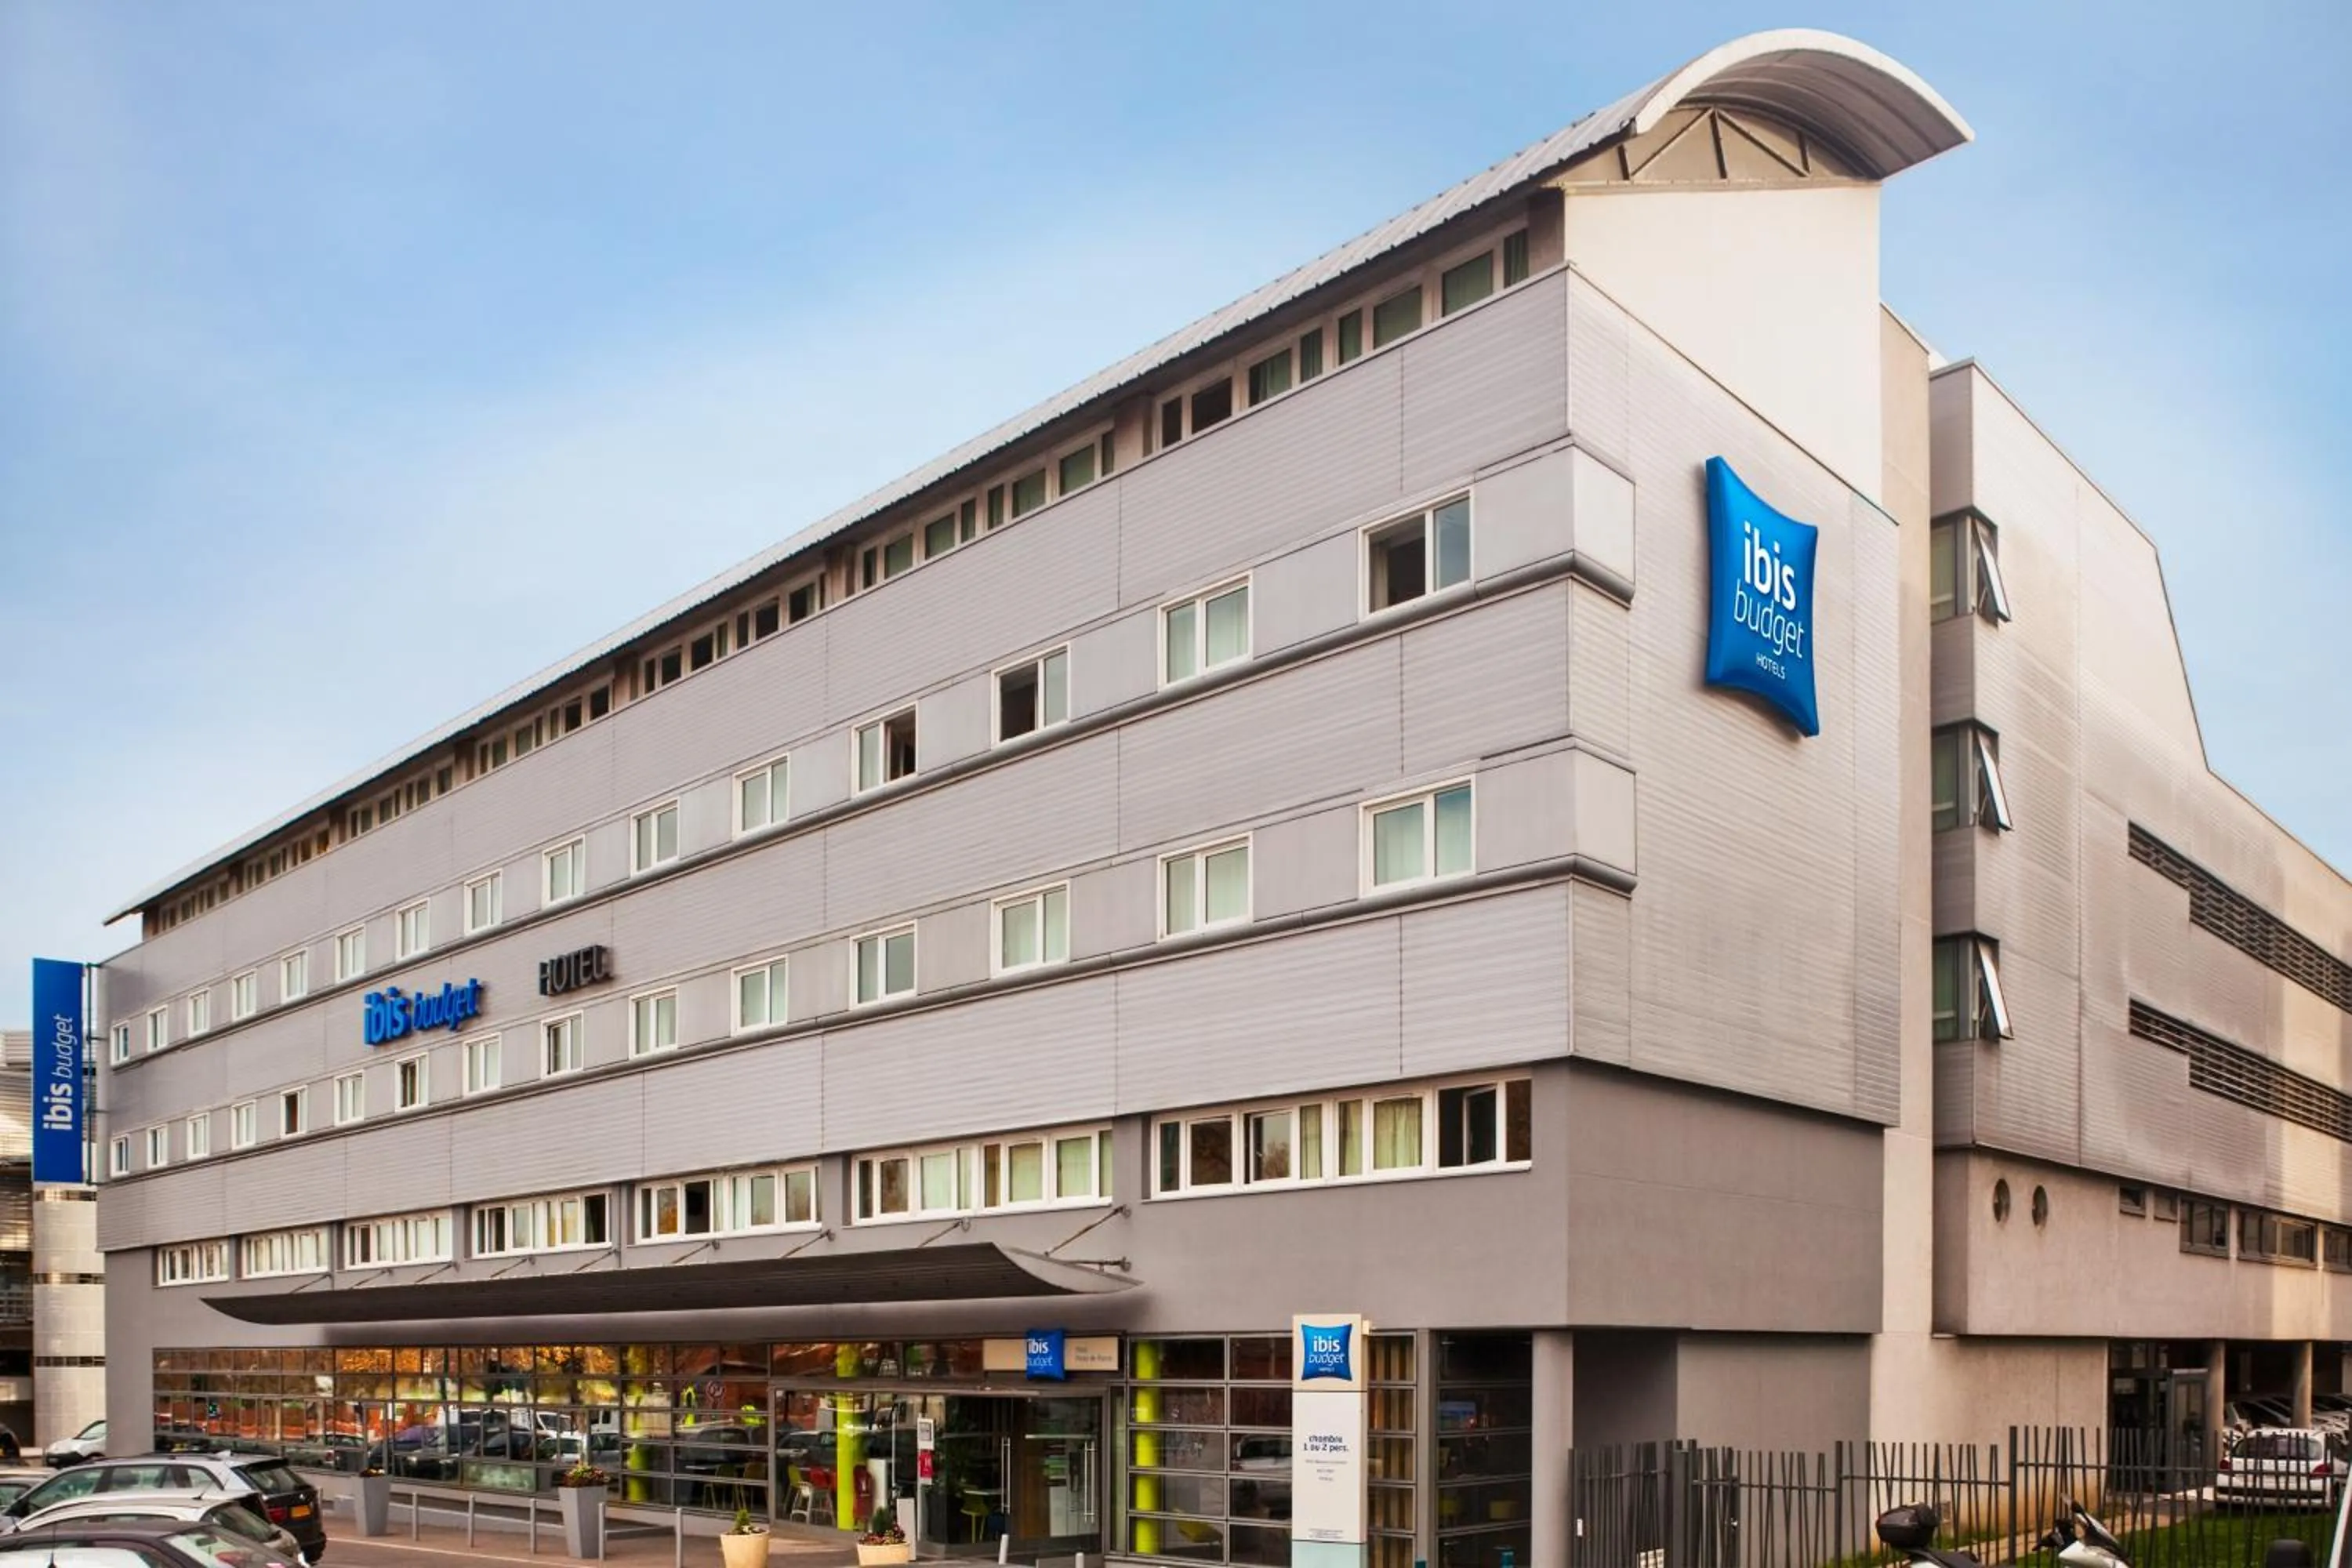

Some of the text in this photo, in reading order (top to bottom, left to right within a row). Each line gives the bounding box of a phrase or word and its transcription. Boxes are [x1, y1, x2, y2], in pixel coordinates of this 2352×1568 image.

[1744, 521, 1796, 611] ibis
[1733, 579, 1805, 659] budget
[1755, 652, 1786, 680] HOTELS
[539, 945, 608, 996] HOTEL
[364, 978, 483, 1046] ibis budget
[42, 1014, 78, 1130] ibis budget
[1028, 1338, 1049, 1354] ibis
[1308, 1352, 1345, 1367] budget
[1312, 1335, 1341, 1352] ibis
